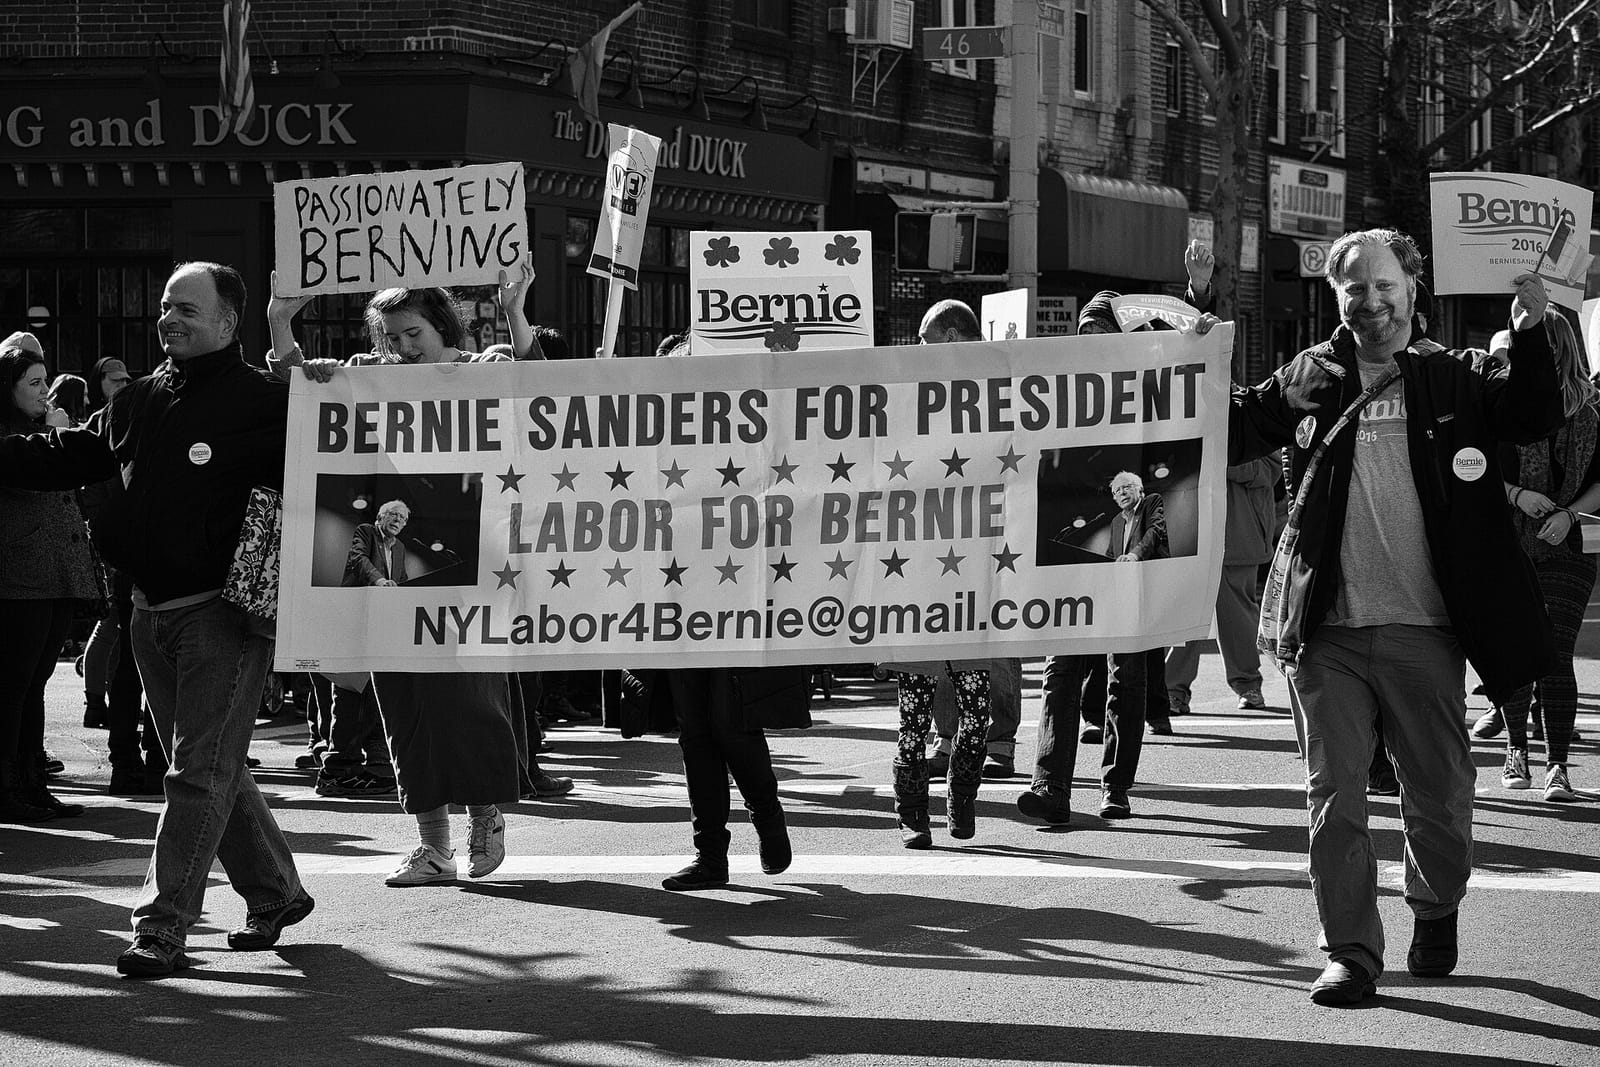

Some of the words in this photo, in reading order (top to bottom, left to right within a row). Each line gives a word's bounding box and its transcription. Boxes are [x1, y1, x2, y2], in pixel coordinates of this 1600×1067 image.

[940, 33, 970, 55] 46
[0, 105, 45, 148] G
[70, 98, 165, 147] and
[189, 103, 357, 147] DUCK
[555, 109, 584, 142] The
[656, 125, 683, 169] nd
[687, 133, 748, 179] DUCK
[294, 170, 518, 229] PASSIONATELY
[1457, 193, 1576, 234] Bernie
[300, 219, 521, 289] BERNING
[1489, 257, 1558, 273] BERNIESANDES.COM
[1511, 238, 1544, 254] 2016
[697, 282, 862, 323] Bernie
[1037, 311, 1050, 322] ME
[1053, 311, 1072, 322] TAX
[317, 398, 502, 455] BERNIE
[528, 389, 769, 451] SANDERS
[795, 384, 889, 441] FOR
[917, 363, 1206, 436] PRESIDENT
[1455, 456, 1484, 467] Bernie
[507, 498, 674, 554] LABOR
[701, 494, 794, 551] FOR
[819, 483, 1006, 545] BERNIE
[413, 591, 1094, 646] NYLabor4Bernie@gmail.com
